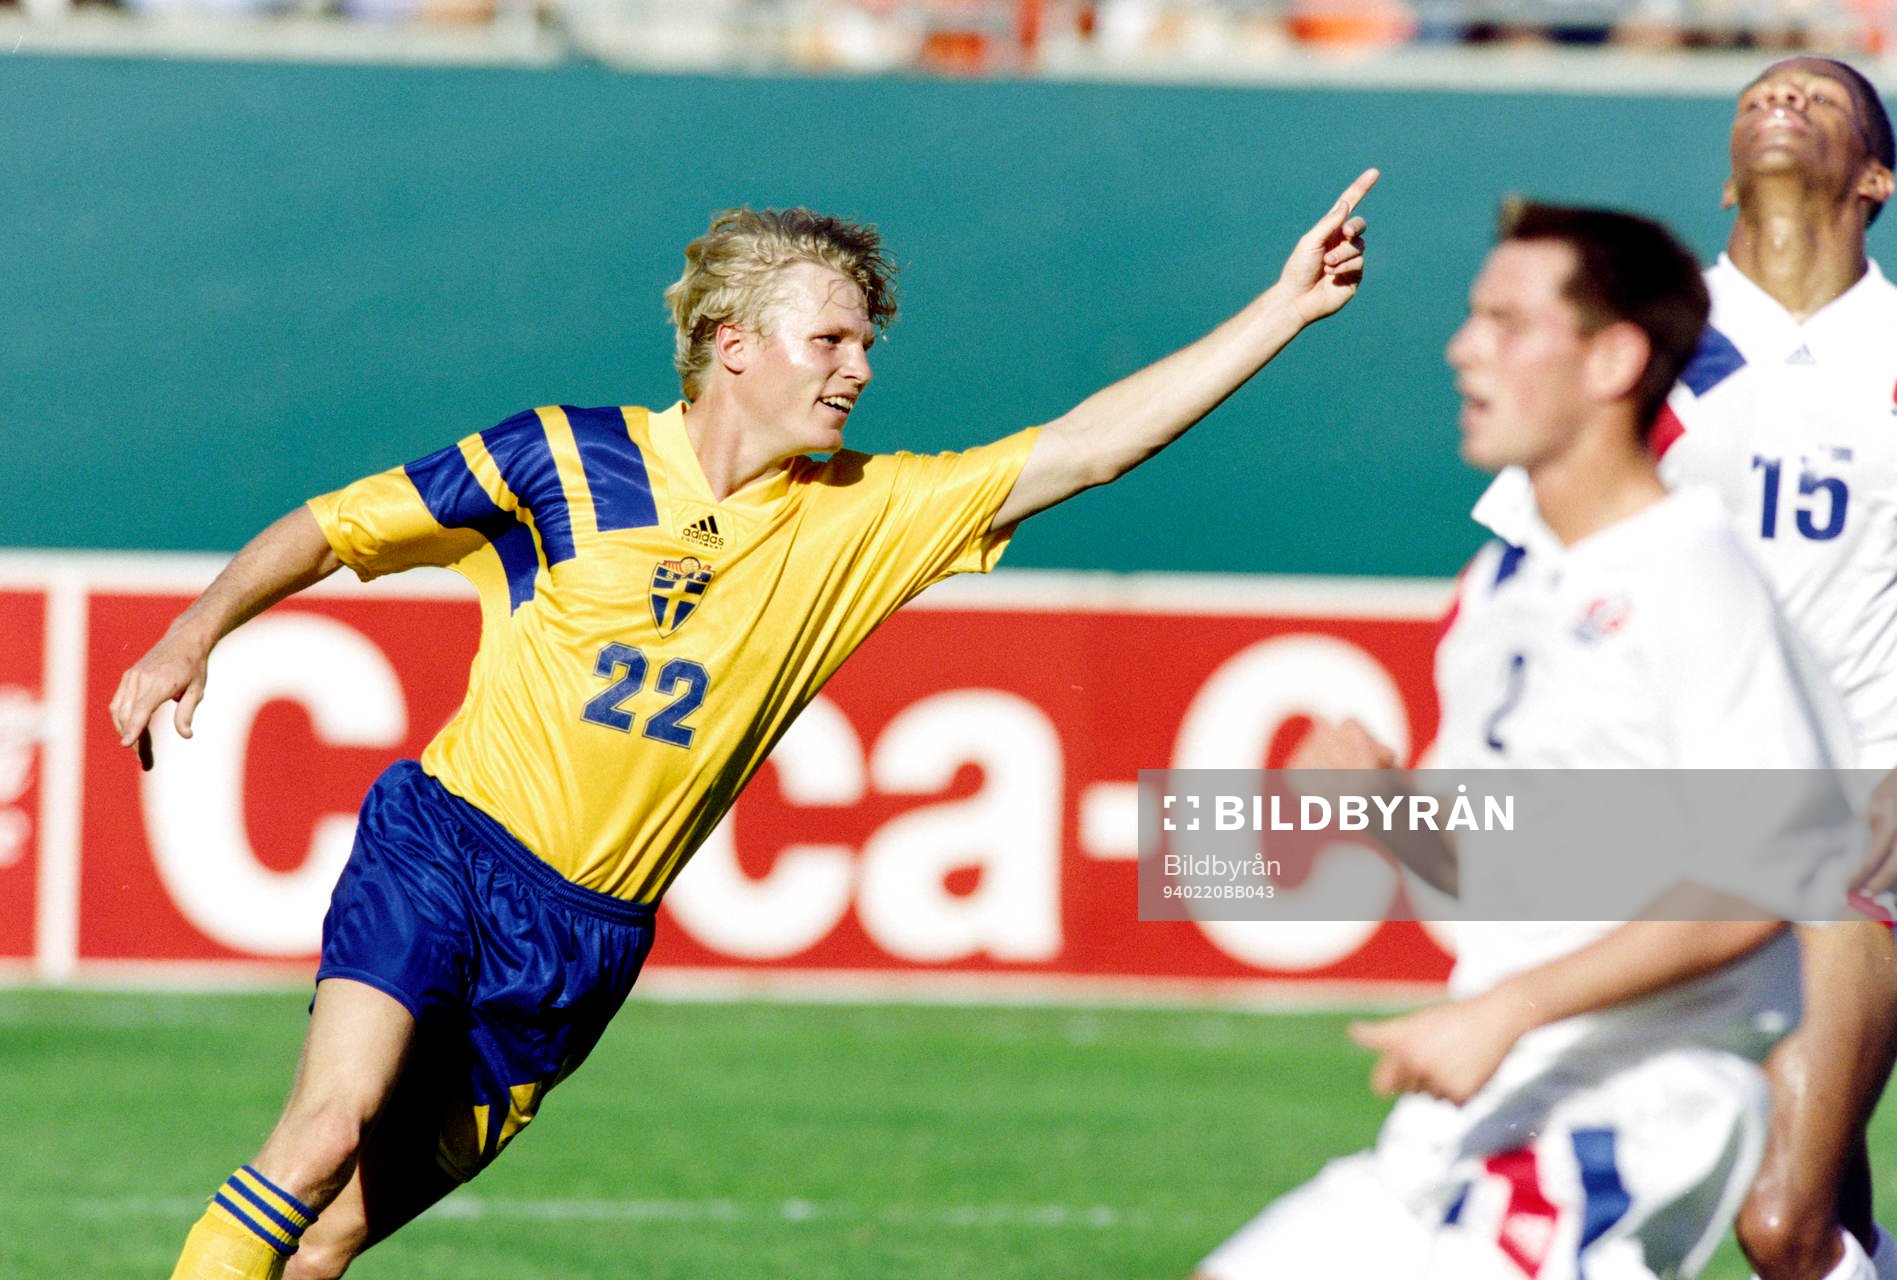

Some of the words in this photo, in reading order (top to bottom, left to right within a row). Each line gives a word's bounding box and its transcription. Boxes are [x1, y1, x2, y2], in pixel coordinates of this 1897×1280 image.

[682, 527, 724, 546] adidas
[1752, 447, 1851, 541] 15
[580, 641, 711, 749] 22
[140, 610, 1458, 976] Cca-C
